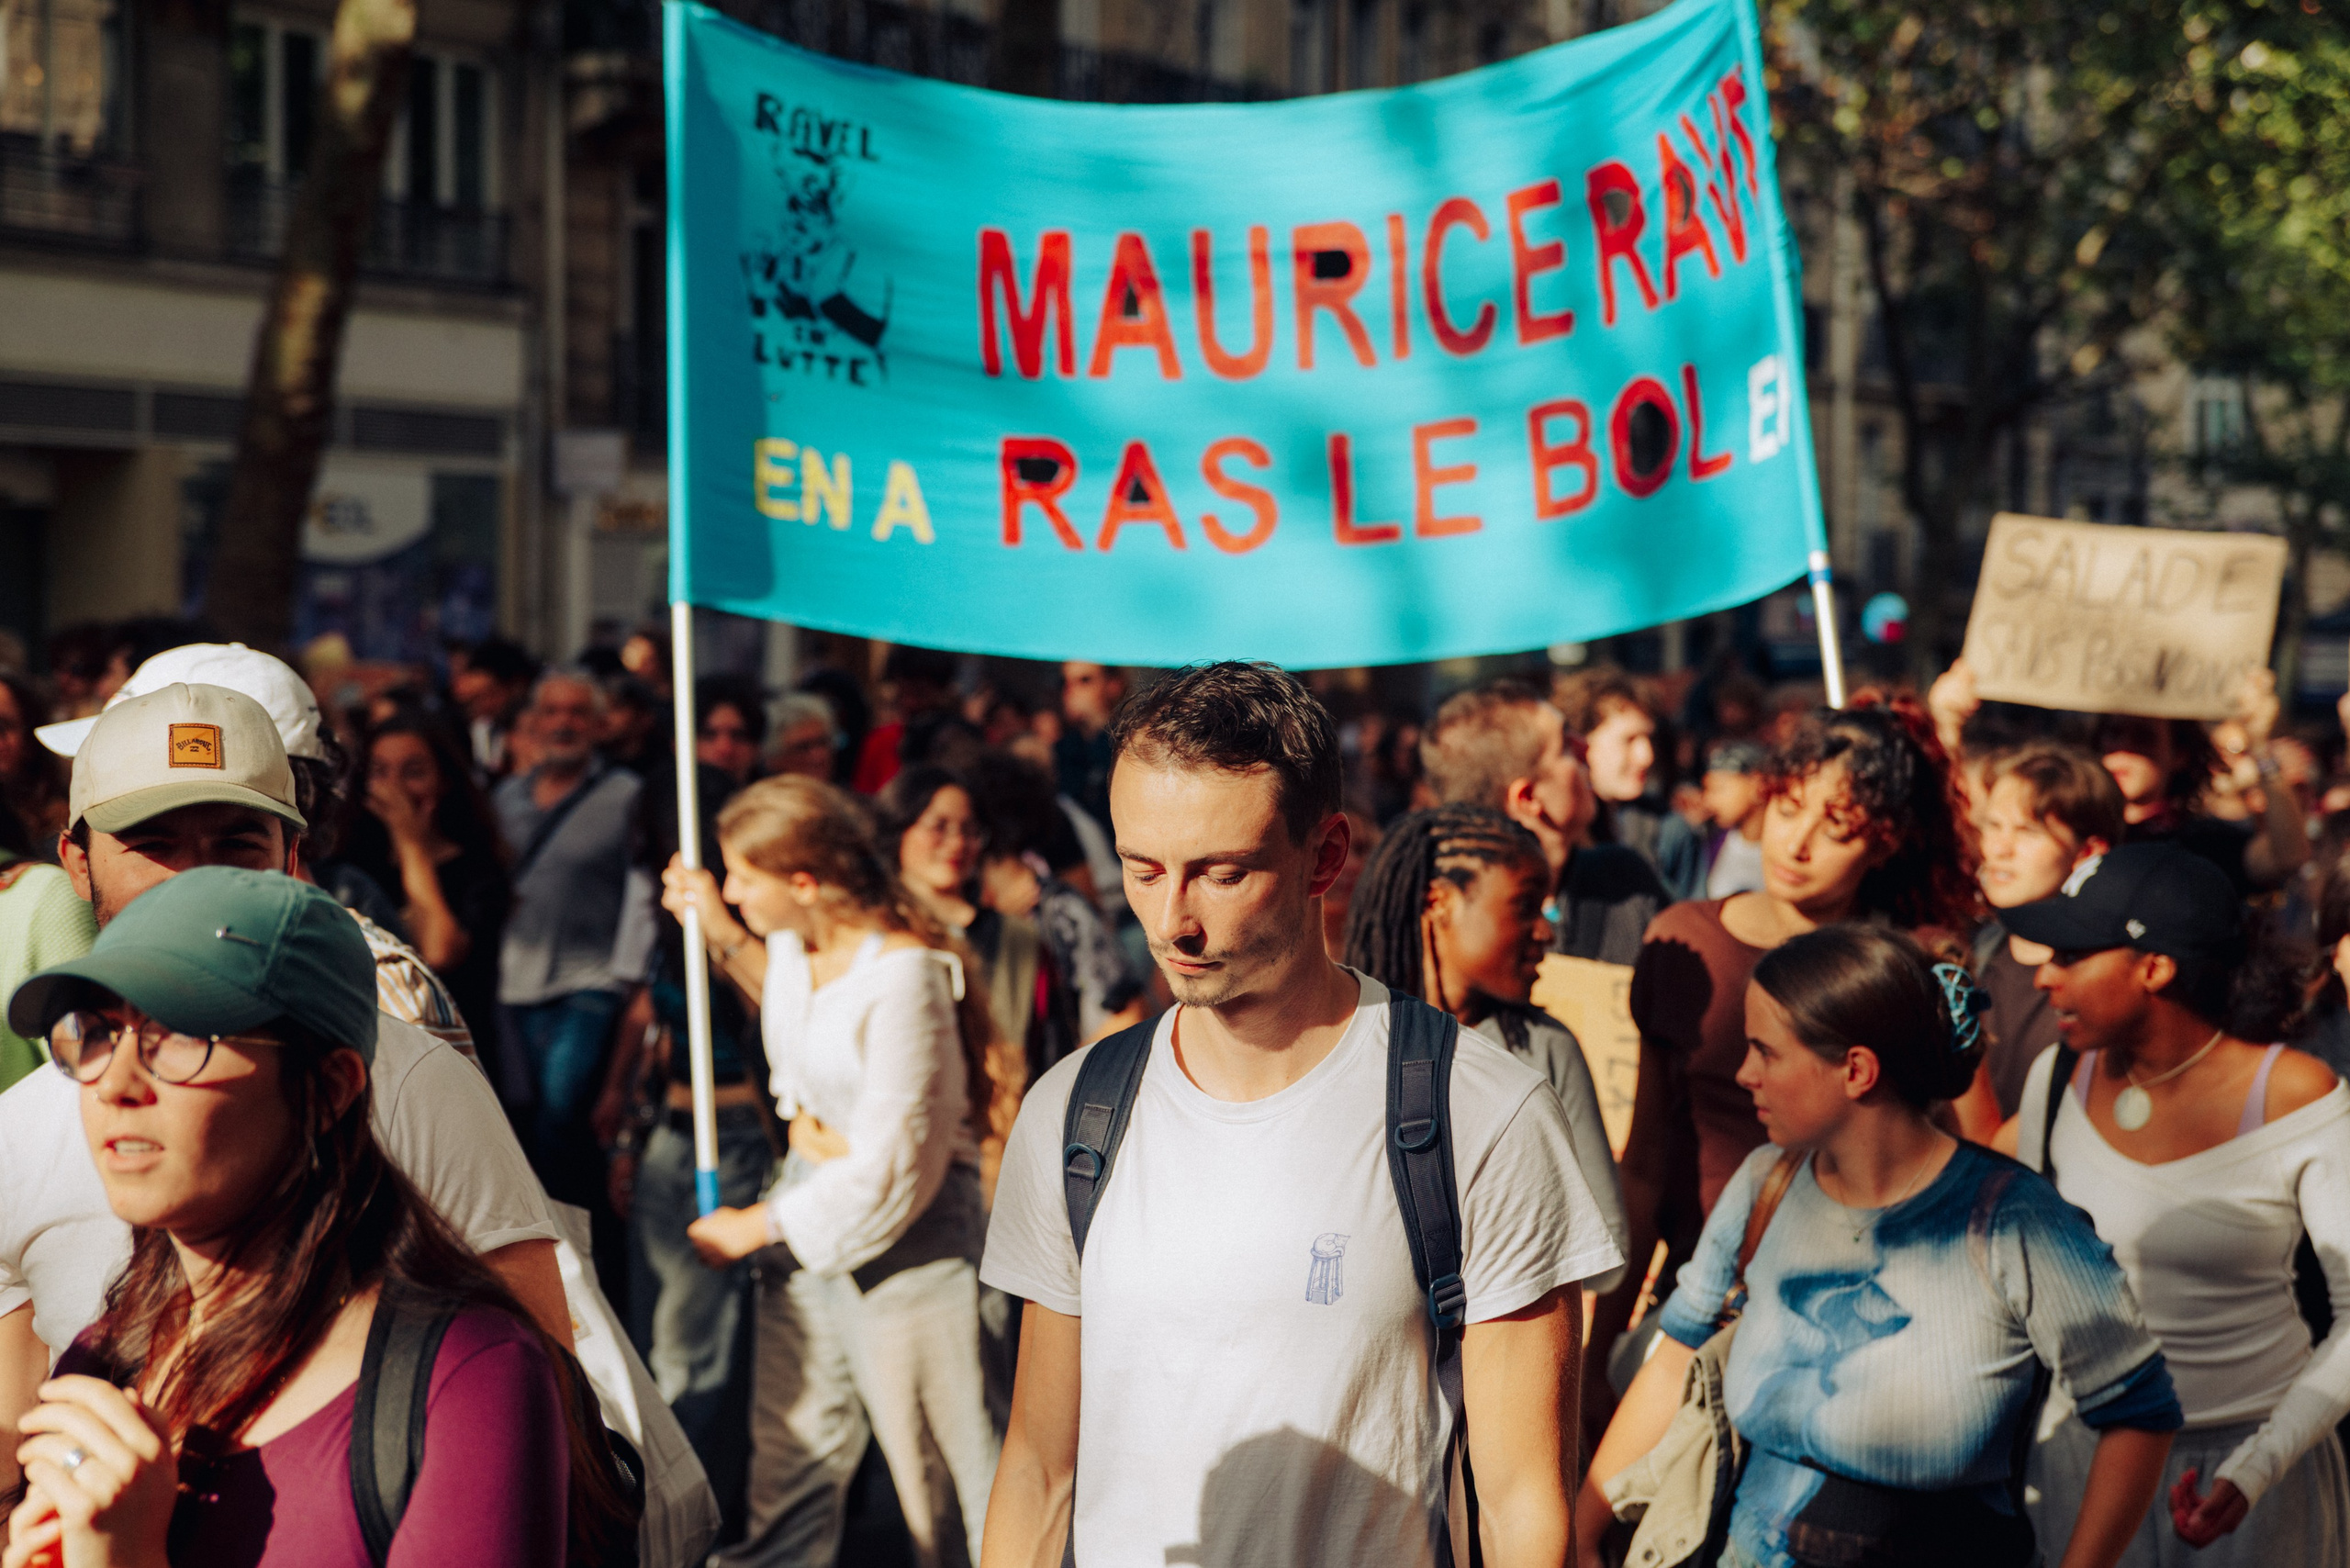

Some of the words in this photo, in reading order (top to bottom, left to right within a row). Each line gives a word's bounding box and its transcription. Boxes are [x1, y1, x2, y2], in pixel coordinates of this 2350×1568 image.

[755, 91, 878, 162] RAVEL
[978, 177, 1573, 382] MAURICE
[754, 437, 853, 531] EN
[871, 460, 936, 544] A
[999, 434, 1280, 553] RAS
[1327, 417, 1483, 544] LE
[1528, 363, 1733, 521] BOL
[1993, 529, 2262, 614] SALADE
